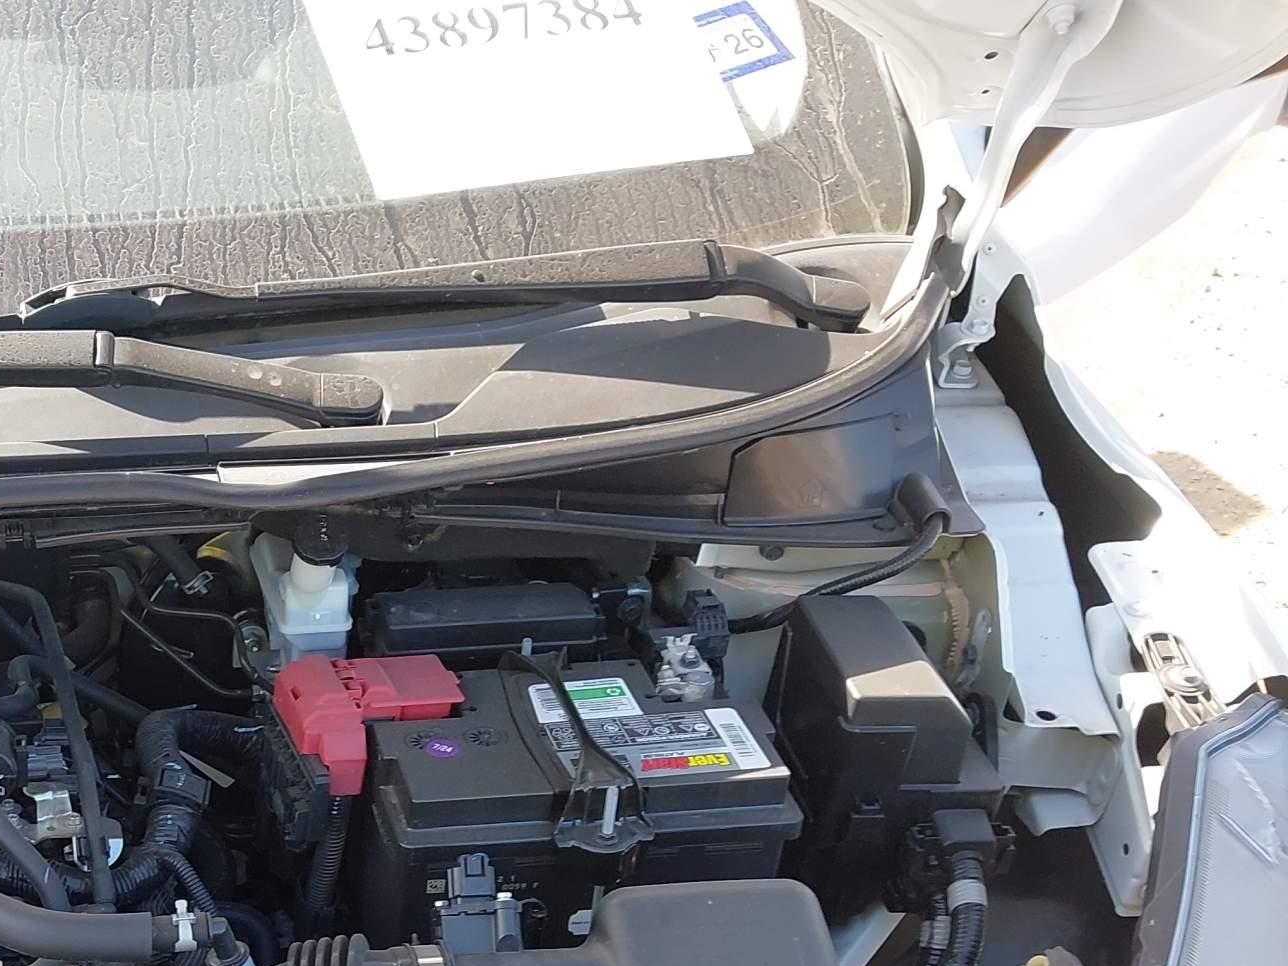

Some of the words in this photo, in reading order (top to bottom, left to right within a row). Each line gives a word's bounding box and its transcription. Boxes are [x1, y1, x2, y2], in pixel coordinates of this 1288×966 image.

[365, 0, 642, 56] 43897384
[723, 28, 764, 55] 26
[431, 743, 454, 753] 7/24
